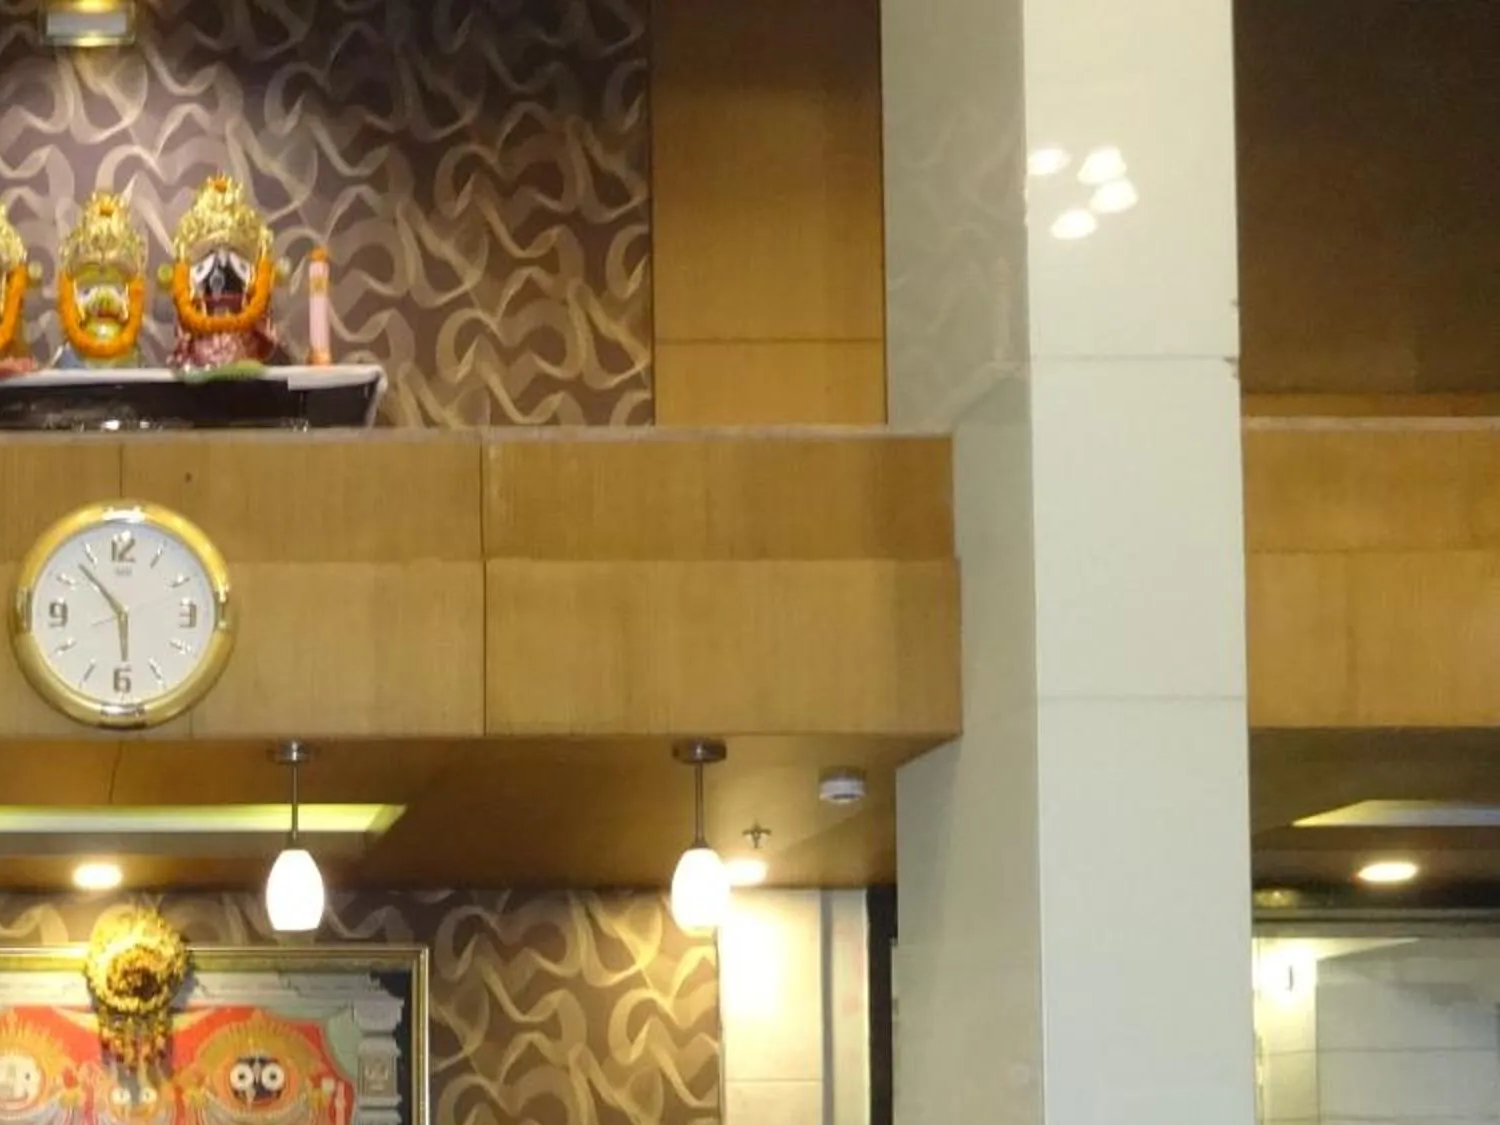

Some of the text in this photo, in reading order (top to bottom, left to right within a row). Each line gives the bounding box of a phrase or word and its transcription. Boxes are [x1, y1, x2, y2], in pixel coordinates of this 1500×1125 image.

[110, 531, 136, 563] 12
[49, 597, 68, 628] 9
[179, 597, 197, 628] 3
[113, 665, 131, 694] 6
